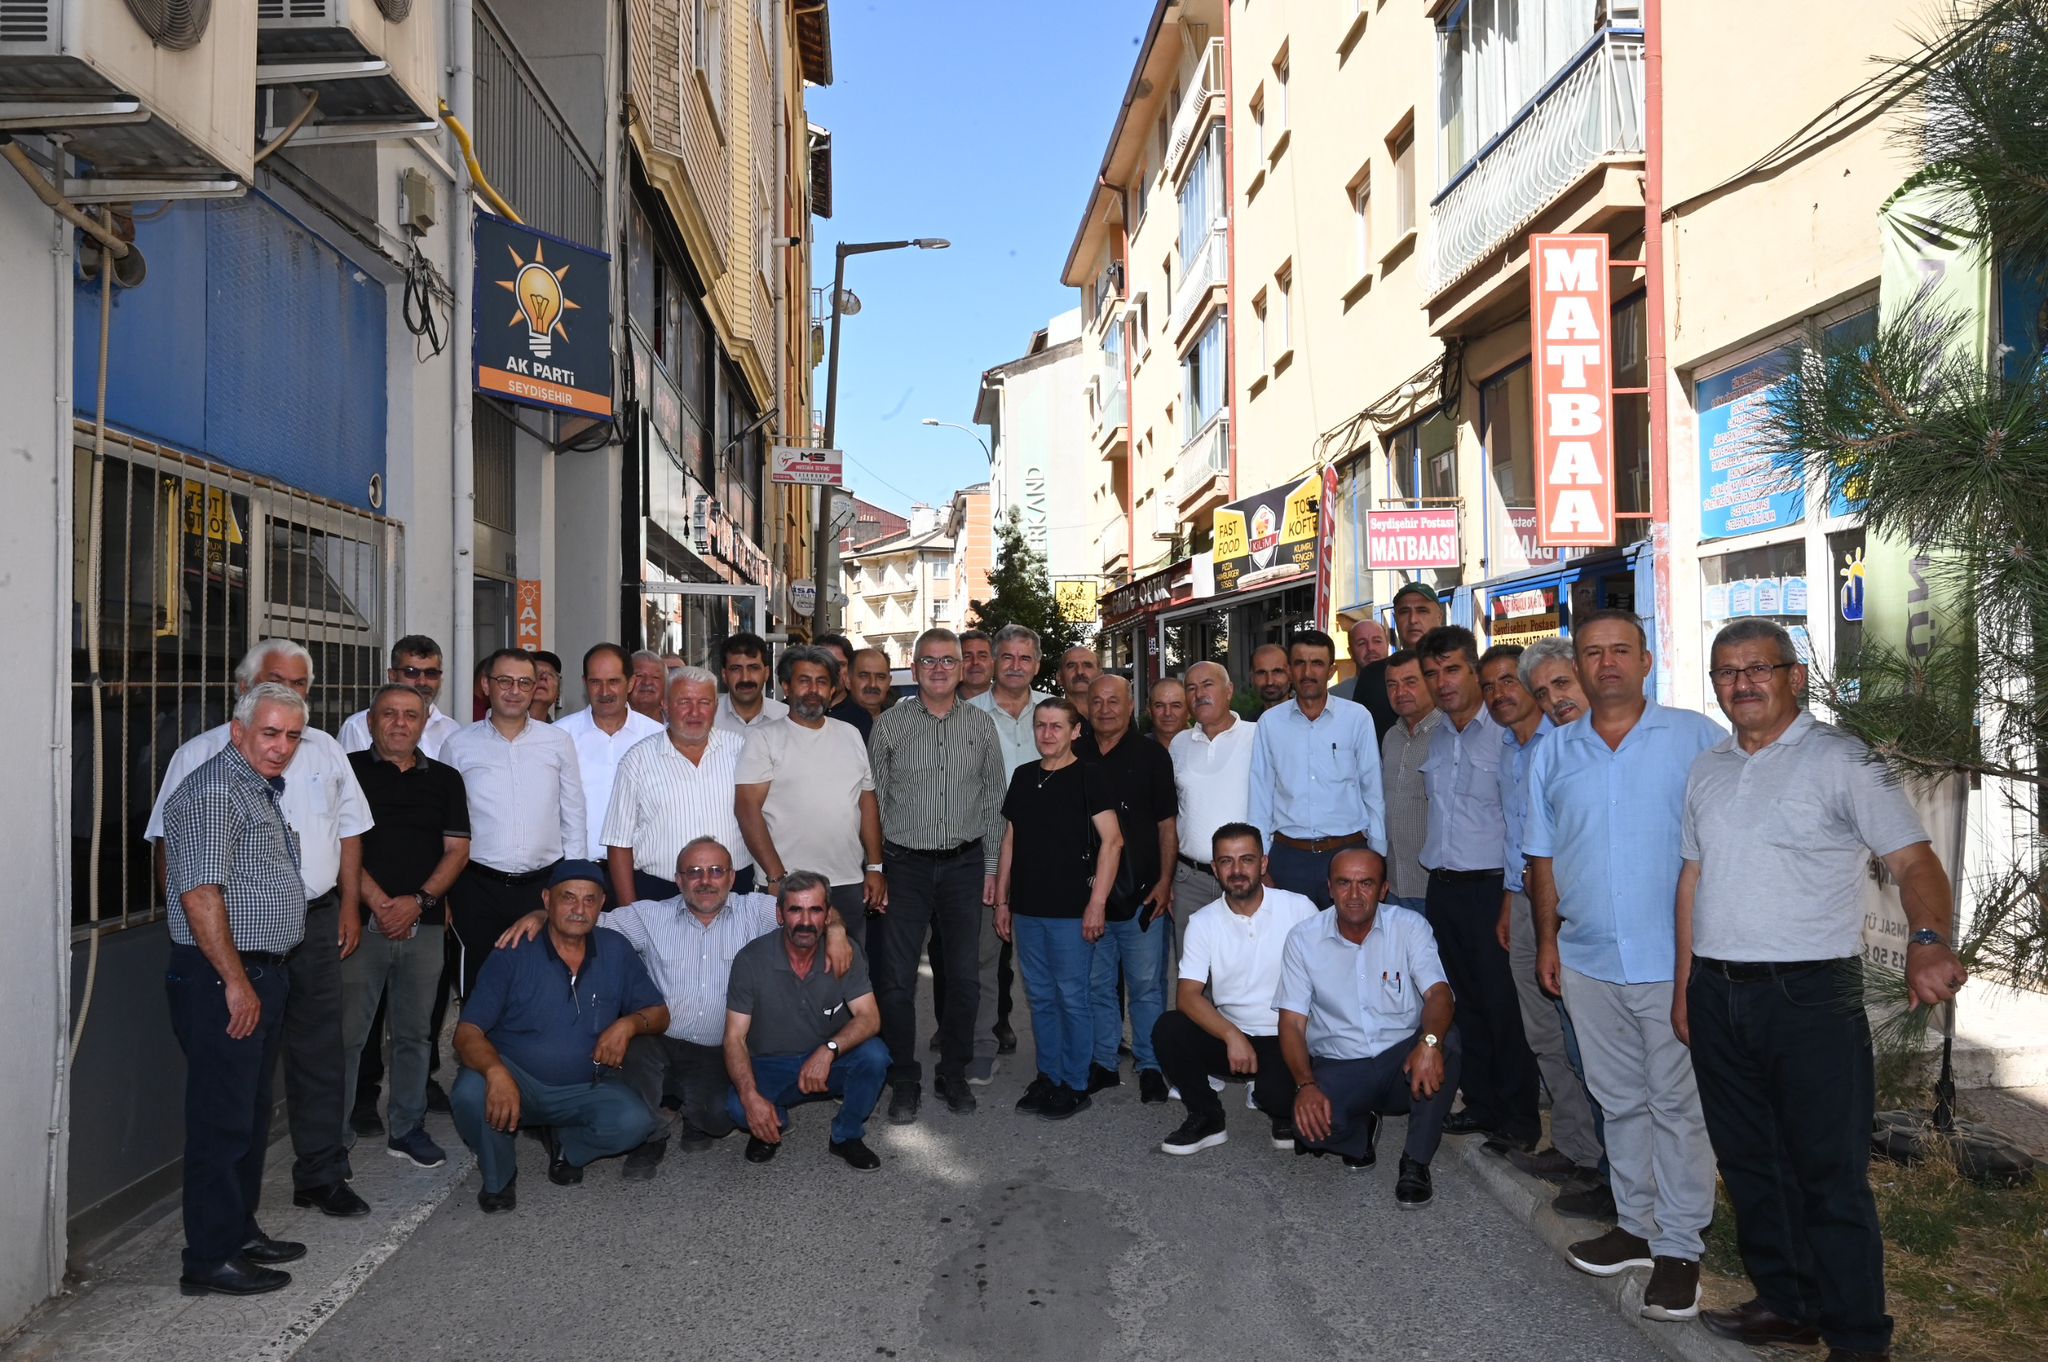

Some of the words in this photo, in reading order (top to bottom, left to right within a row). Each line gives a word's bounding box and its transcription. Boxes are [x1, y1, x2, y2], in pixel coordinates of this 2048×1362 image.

[506, 356, 529, 374] AK
[508, 380, 573, 405] SEYDİŞEHİR
[1544, 248, 1604, 533] MATBAA
[800, 452, 826, 462] MS
[1219, 521, 1238, 539] FAST
[1371, 517, 1418, 532] Seydişehir
[1421, 517, 1455, 529] Postası
[1218, 538, 1241, 556] FOOD
[1371, 535, 1456, 561] MATBAASI
[520, 606, 537, 637] AK
[1530, 619, 1556, 632] Postası
